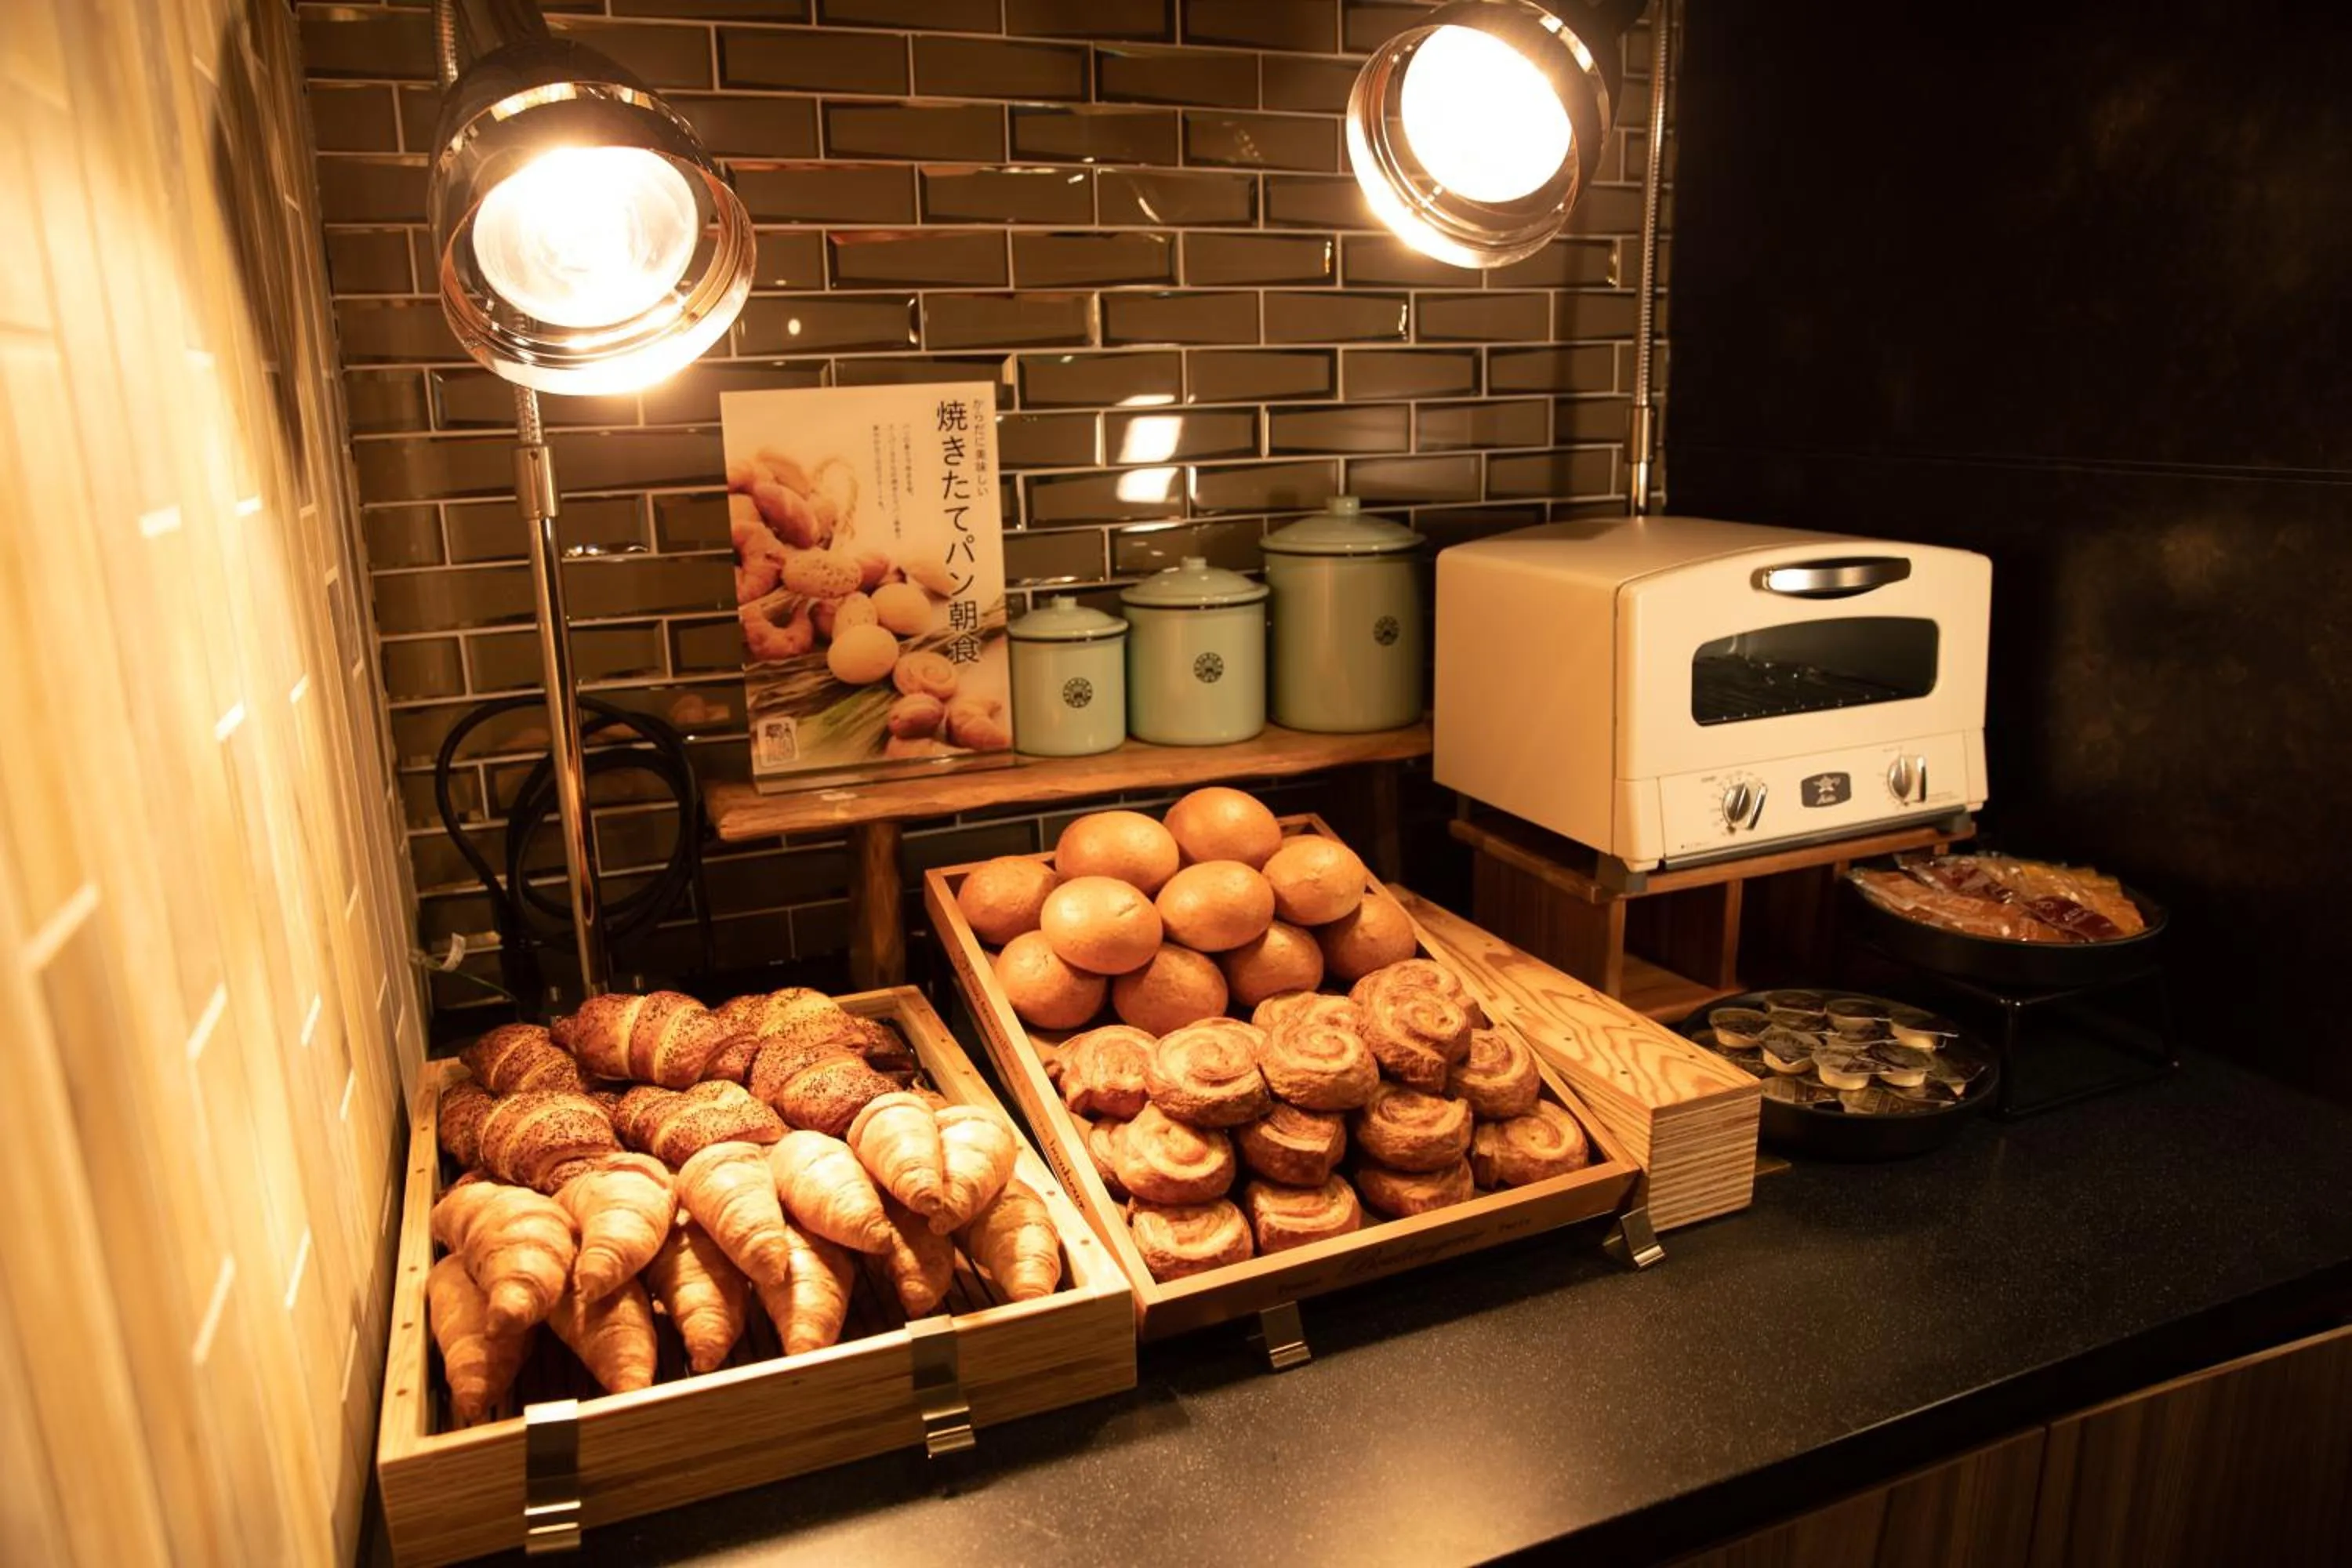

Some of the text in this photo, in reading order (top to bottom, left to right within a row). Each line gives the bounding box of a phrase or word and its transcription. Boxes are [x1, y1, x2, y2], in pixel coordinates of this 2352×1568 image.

[937, 400, 979, 665] 焼きたてパン朝食
